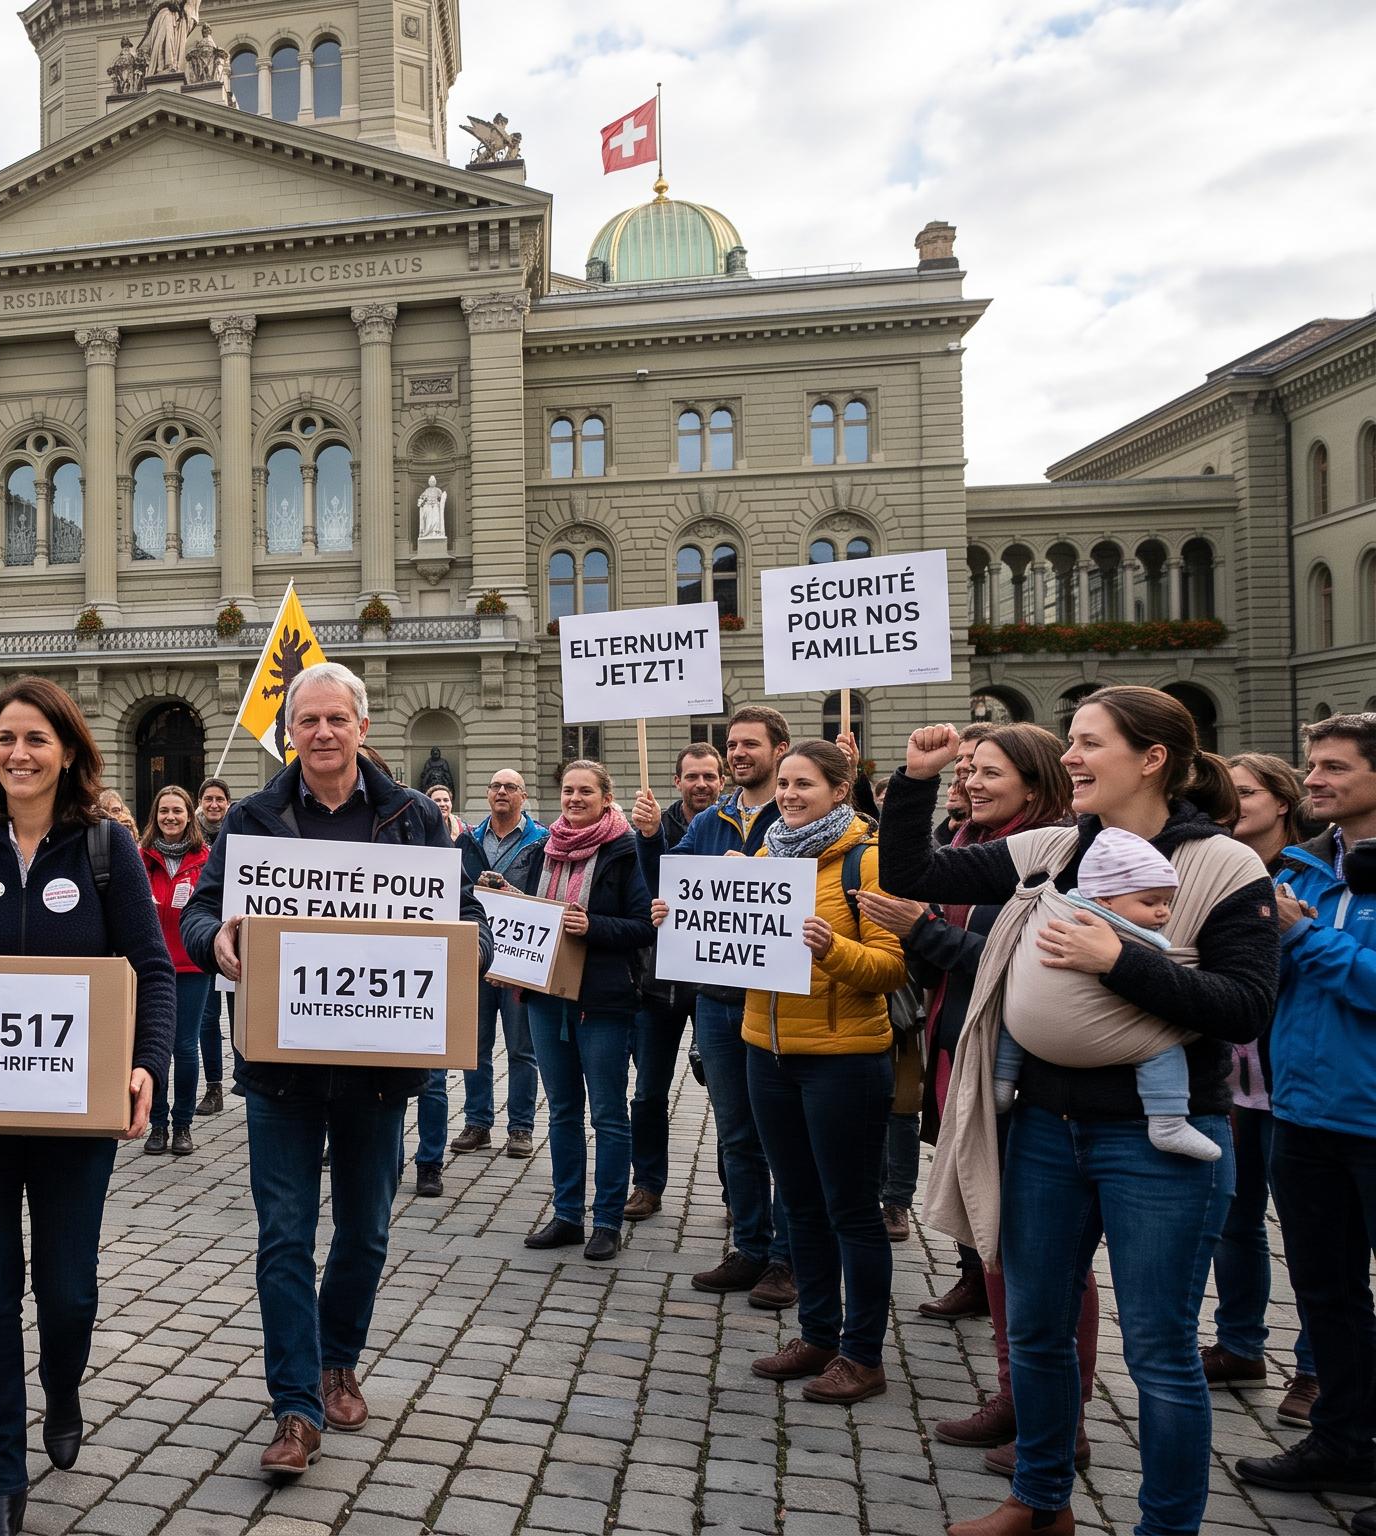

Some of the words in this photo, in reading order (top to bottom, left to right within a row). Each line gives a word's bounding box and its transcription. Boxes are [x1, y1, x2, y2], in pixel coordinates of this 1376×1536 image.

[790, 566, 916, 604] SÉCURITÉ
[788, 607, 858, 633] POUR
[866, 601, 920, 626] NOS
[570, 628, 709, 659] ELTERNUMT
[791, 630, 918, 661] FAMILLES
[595, 658, 684, 687] JETZT!
[237, 860, 366, 894] SÉCURITÉ
[372, 873, 445, 899] POUR
[678, 878, 704, 901] 36
[710, 879, 792, 905] WEEKS
[245, 894, 299, 916] NOS
[674, 908, 793, 938] PARENTAL
[695, 940, 766, 968] LEAVE
[293, 965, 434, 999] 112'517
[290, 1002, 434, 1020] UNTERSCHRIFTEN
